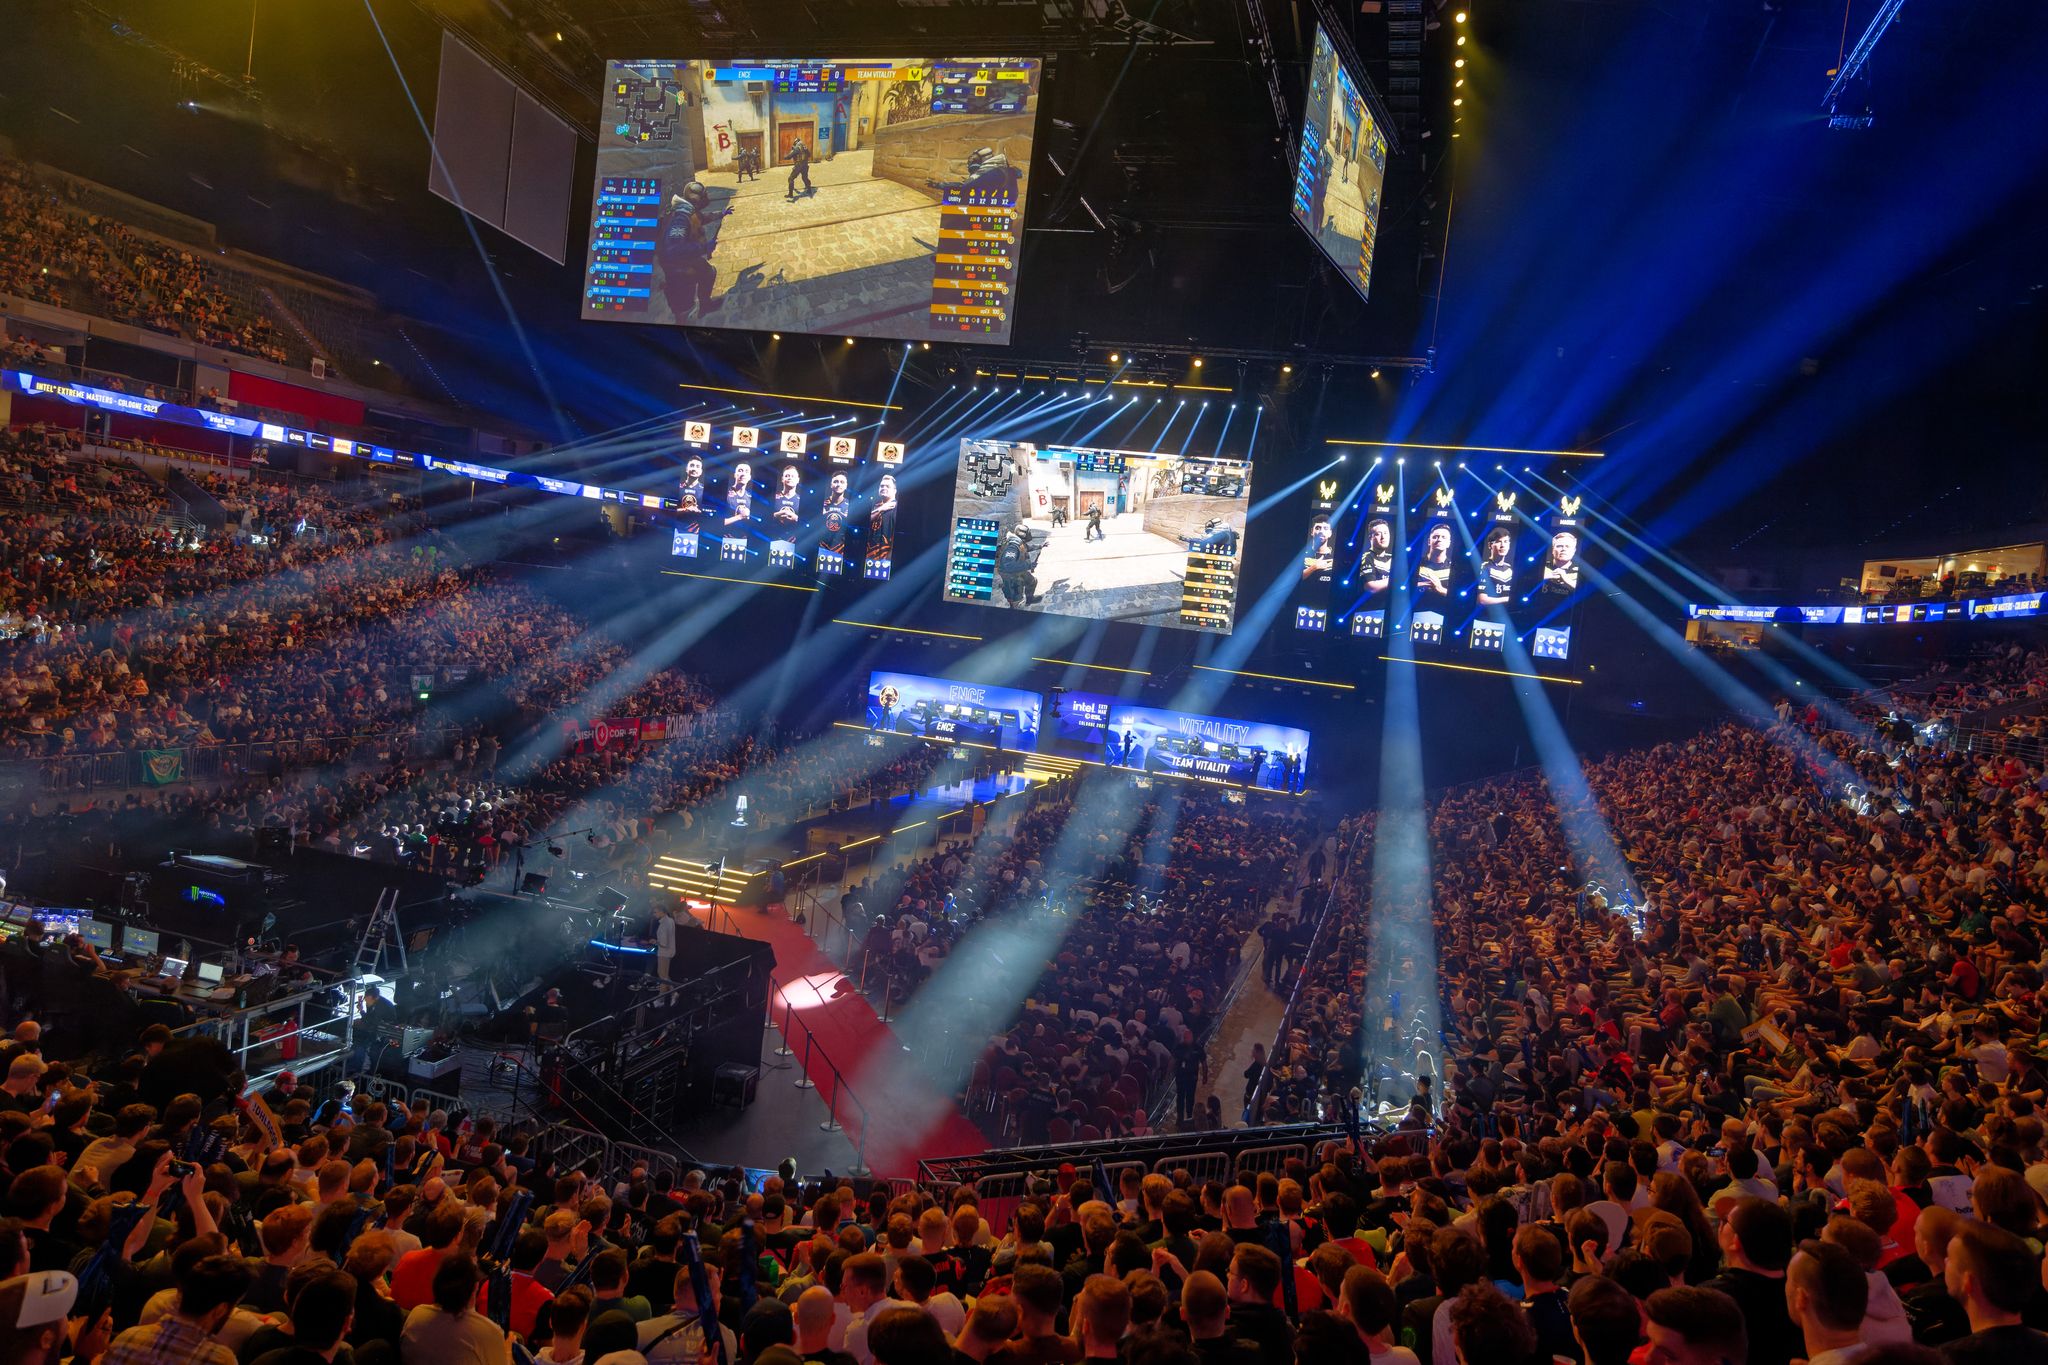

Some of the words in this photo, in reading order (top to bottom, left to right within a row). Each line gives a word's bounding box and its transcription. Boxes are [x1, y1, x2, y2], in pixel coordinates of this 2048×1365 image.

[780, 71, 785, 79] 0
[872, 71, 896, 79] VITALITY
[835, 103, 847, 119] A
[718, 133, 731, 151] B
[57, 386, 86, 399] EXTREME
[86, 392, 113, 405] MASTERS
[118, 398, 143, 411] COLOGNE
[143, 403, 158, 414] 2023
[1039, 494, 1047, 506] B
[950, 685, 986, 706] ENCE
[1073, 701, 1095, 713] intel
[936, 721, 956, 733] ENCE
[1179, 717, 1249, 744] VITALITY
[1171, 756, 1194, 769] TEAM
[1195, 759, 1231, 774] VITALITY
